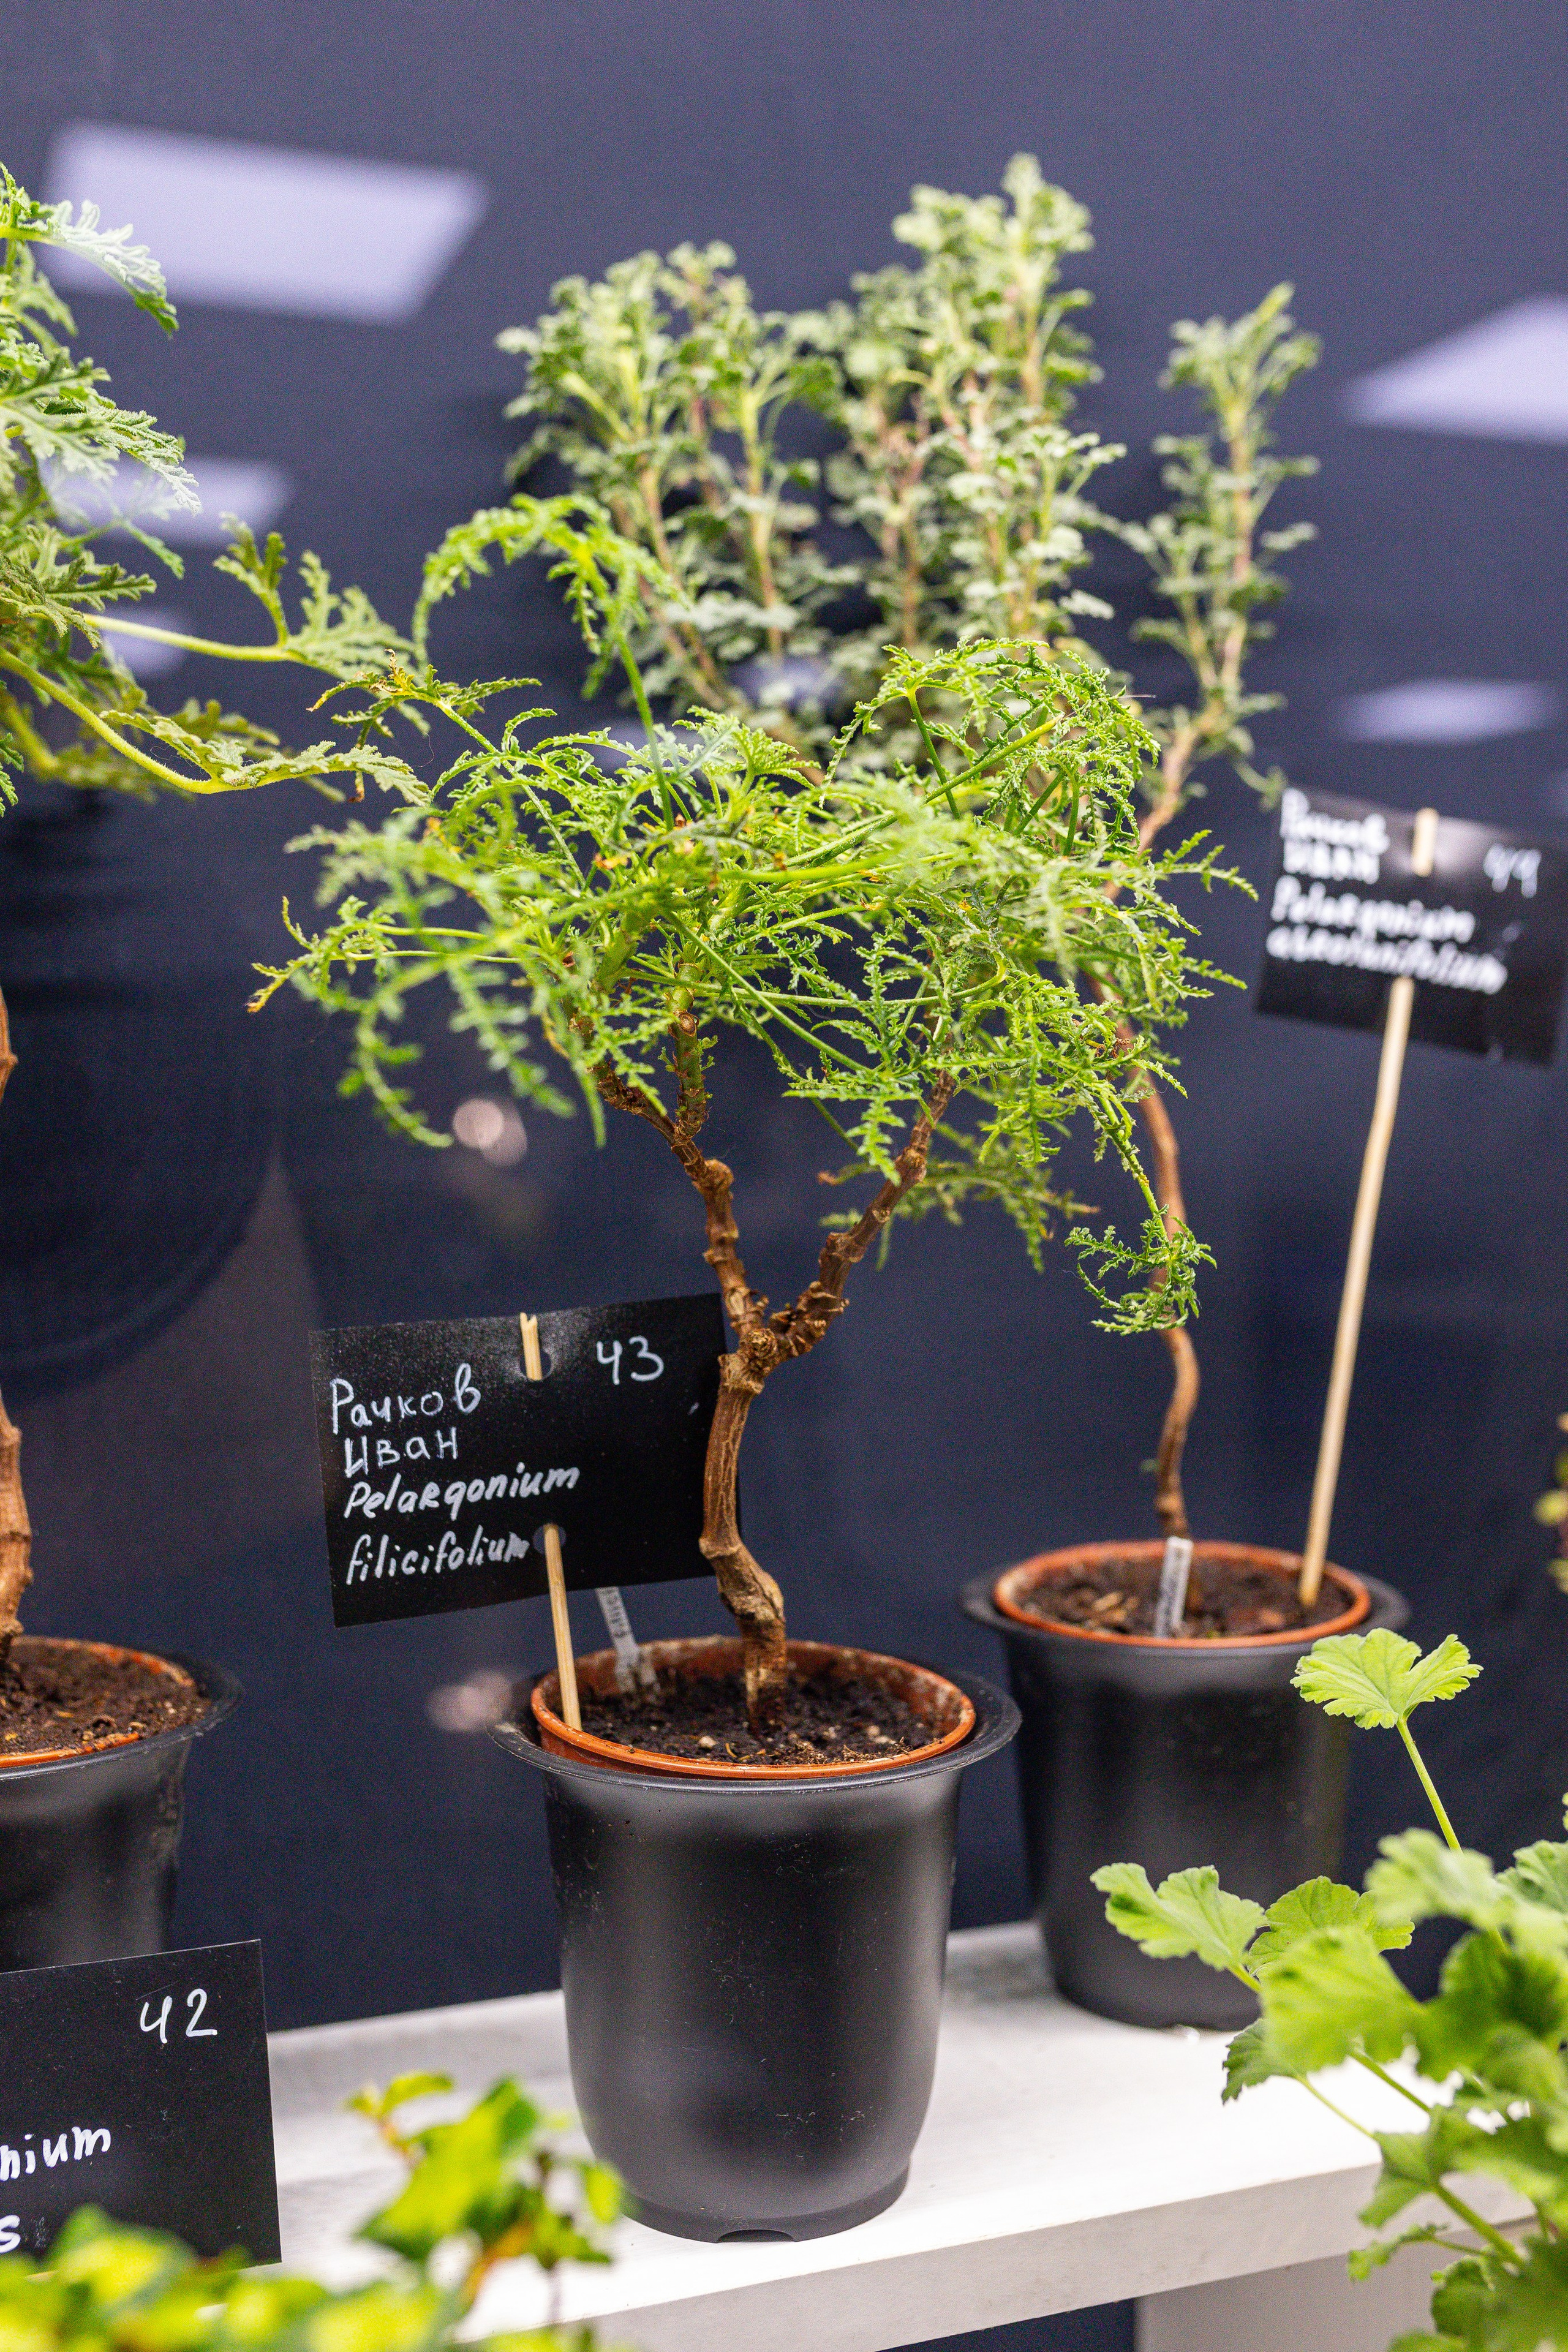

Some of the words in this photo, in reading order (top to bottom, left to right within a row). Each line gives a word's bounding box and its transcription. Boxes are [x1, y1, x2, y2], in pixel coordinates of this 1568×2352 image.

[596, 1335, 665, 1385] 43
[330, 1363, 481, 1434] Рачков
[344, 1427, 458, 1479] Иван
[345, 1524, 530, 1585] filicifolium
[140, 1988, 217, 2043] 42
